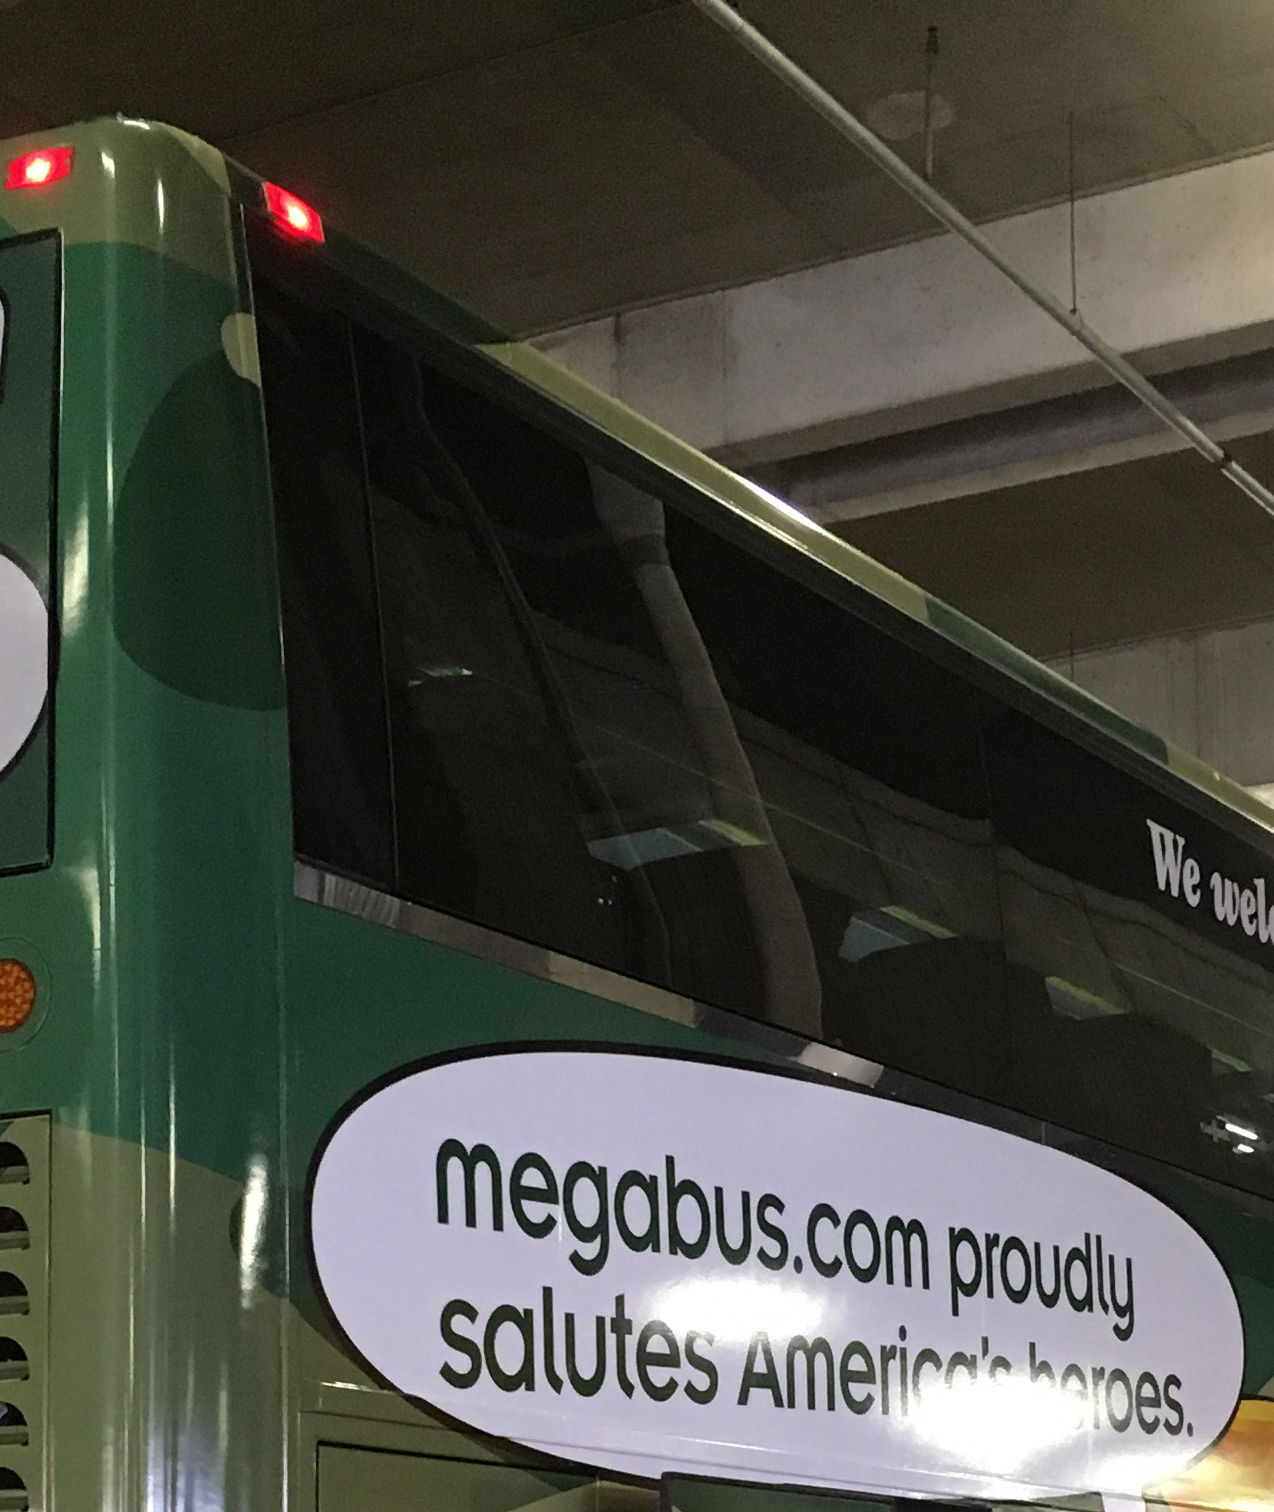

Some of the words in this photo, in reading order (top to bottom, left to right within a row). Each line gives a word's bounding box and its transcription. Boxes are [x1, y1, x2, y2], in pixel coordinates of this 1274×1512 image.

[1146, 818, 1201, 908] We
[436, 1137, 930, 1290] megabus.com
[947, 1221, 1135, 1341] proudly
[438, 1286, 719, 1406] salutes
